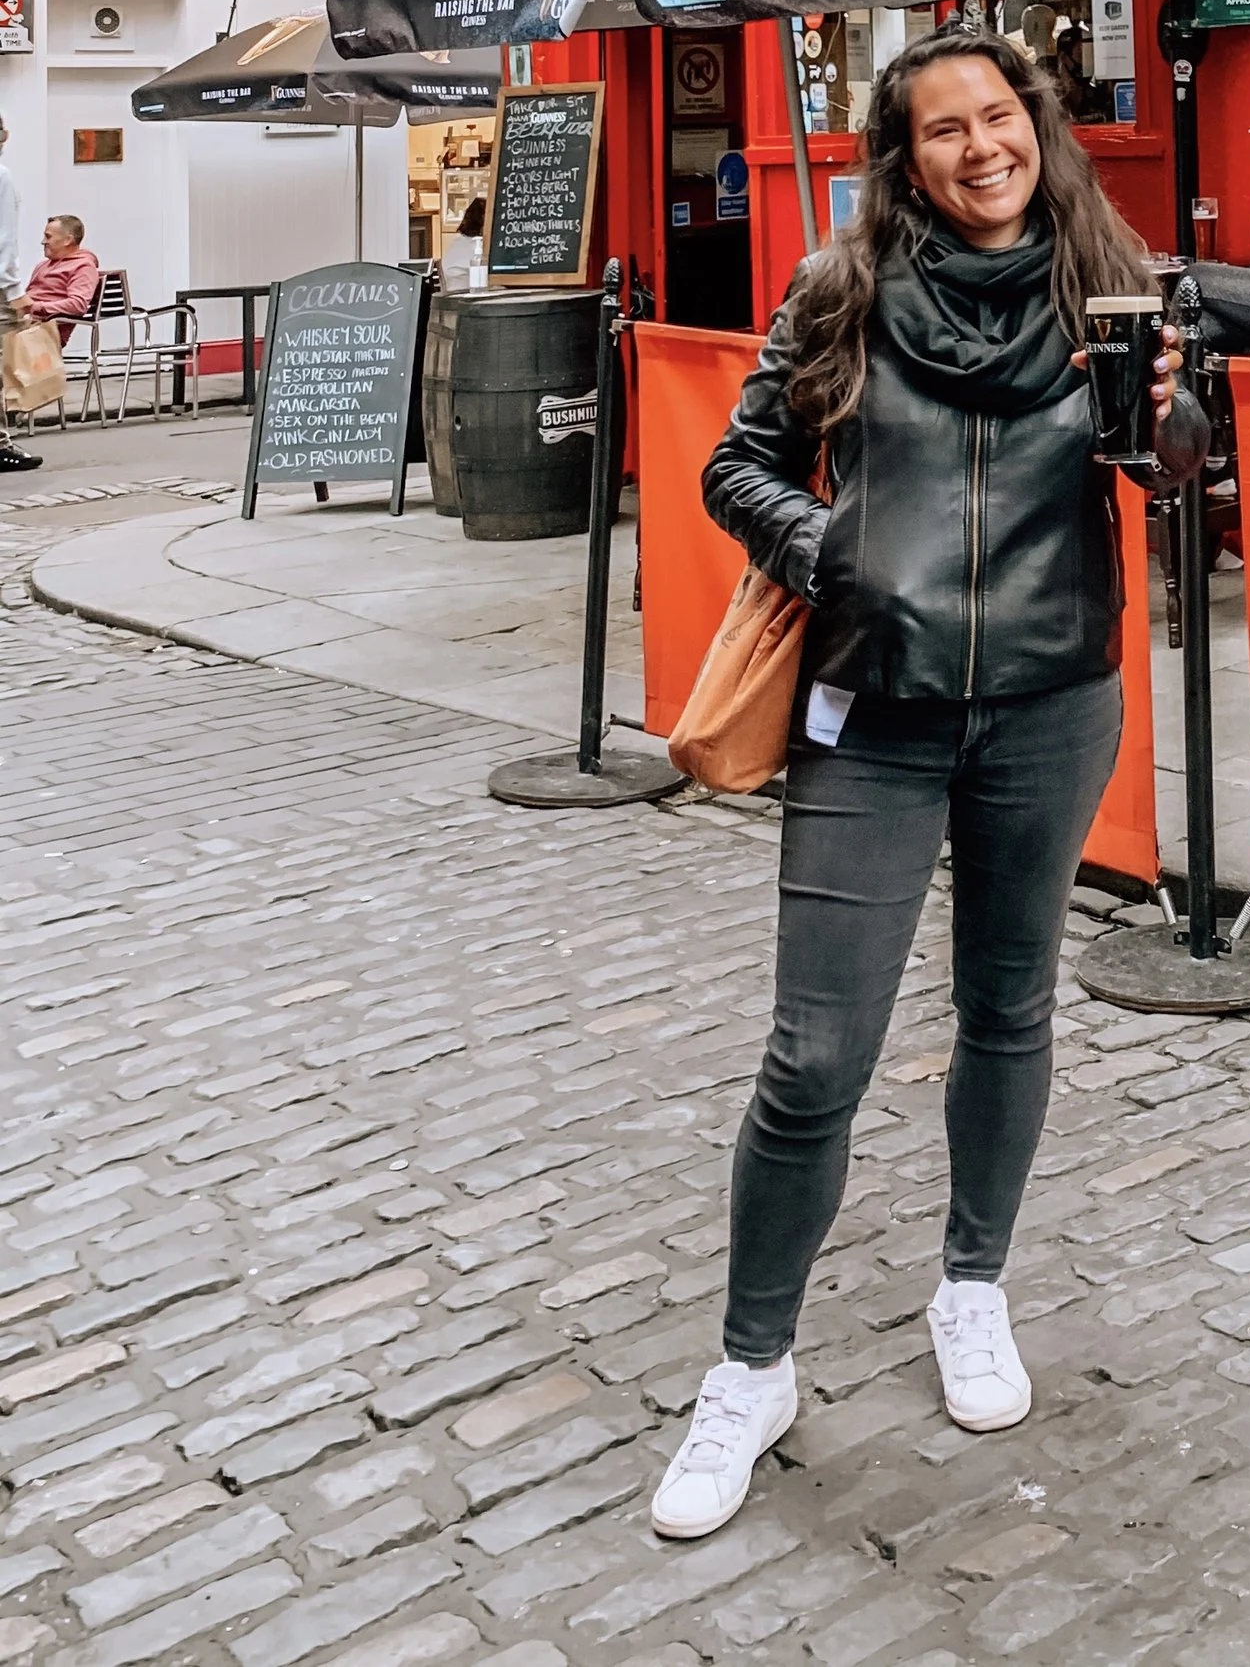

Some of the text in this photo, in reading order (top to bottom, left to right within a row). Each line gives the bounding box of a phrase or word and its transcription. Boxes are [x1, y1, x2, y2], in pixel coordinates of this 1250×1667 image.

[411, 84, 490, 95] RAISING THE BAR
[506, 99, 536, 114] TAKE
[567, 95, 587, 108] SIT
[530, 112, 567, 124] GUINNESS
[576, 107, 588, 117] IN
[511, 139, 567, 155] GUINNESS
[508, 167, 580, 185] COORS LIGHT
[506, 181, 569, 198] CARLSBERG
[507, 195, 530, 208] HOP
[532, 194, 561, 206] HOUSE
[506, 205, 564, 220] BULMERS
[548, 219, 581, 233] THIEVES
[531, 241, 569, 256] LAGER
[530, 253, 564, 265] CIDER
[288, 282, 400, 313] COCKTAILS
[284, 324, 392, 347] WHISKEY SOUR
[284, 348, 396, 366] PORNSTAR MARTINI
[282, 366, 389, 384] ESPRESSO MARTINI
[279, 380, 374, 397] COSMOPOLITAN
[276, 398, 361, 414] MARGARITA
[274, 412, 398, 428] SEX ON THE BEACH
[542, 406, 598, 427] BUSHMIL
[273, 427, 382, 446] PINK GIN LADY
[270, 453, 307, 470] OLD
